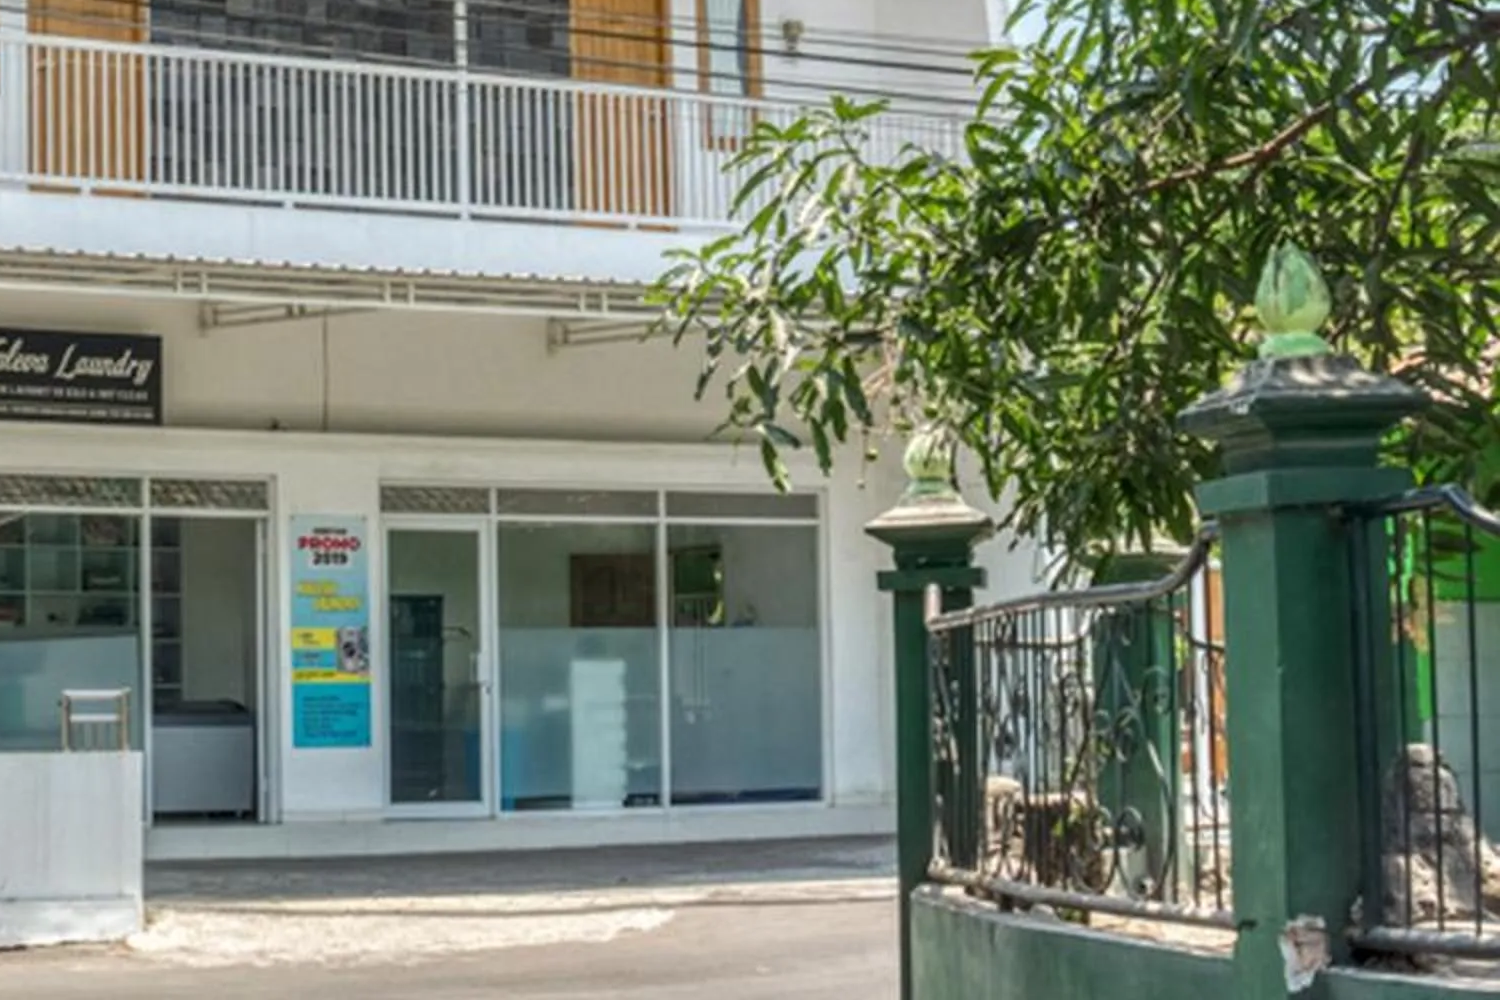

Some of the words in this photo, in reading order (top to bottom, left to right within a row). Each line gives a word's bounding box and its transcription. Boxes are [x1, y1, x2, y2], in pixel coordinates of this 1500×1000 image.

[53, 343, 154, 385] Laundry
[297, 536, 361, 552] PROMO
[313, 552, 348, 566] 2019
